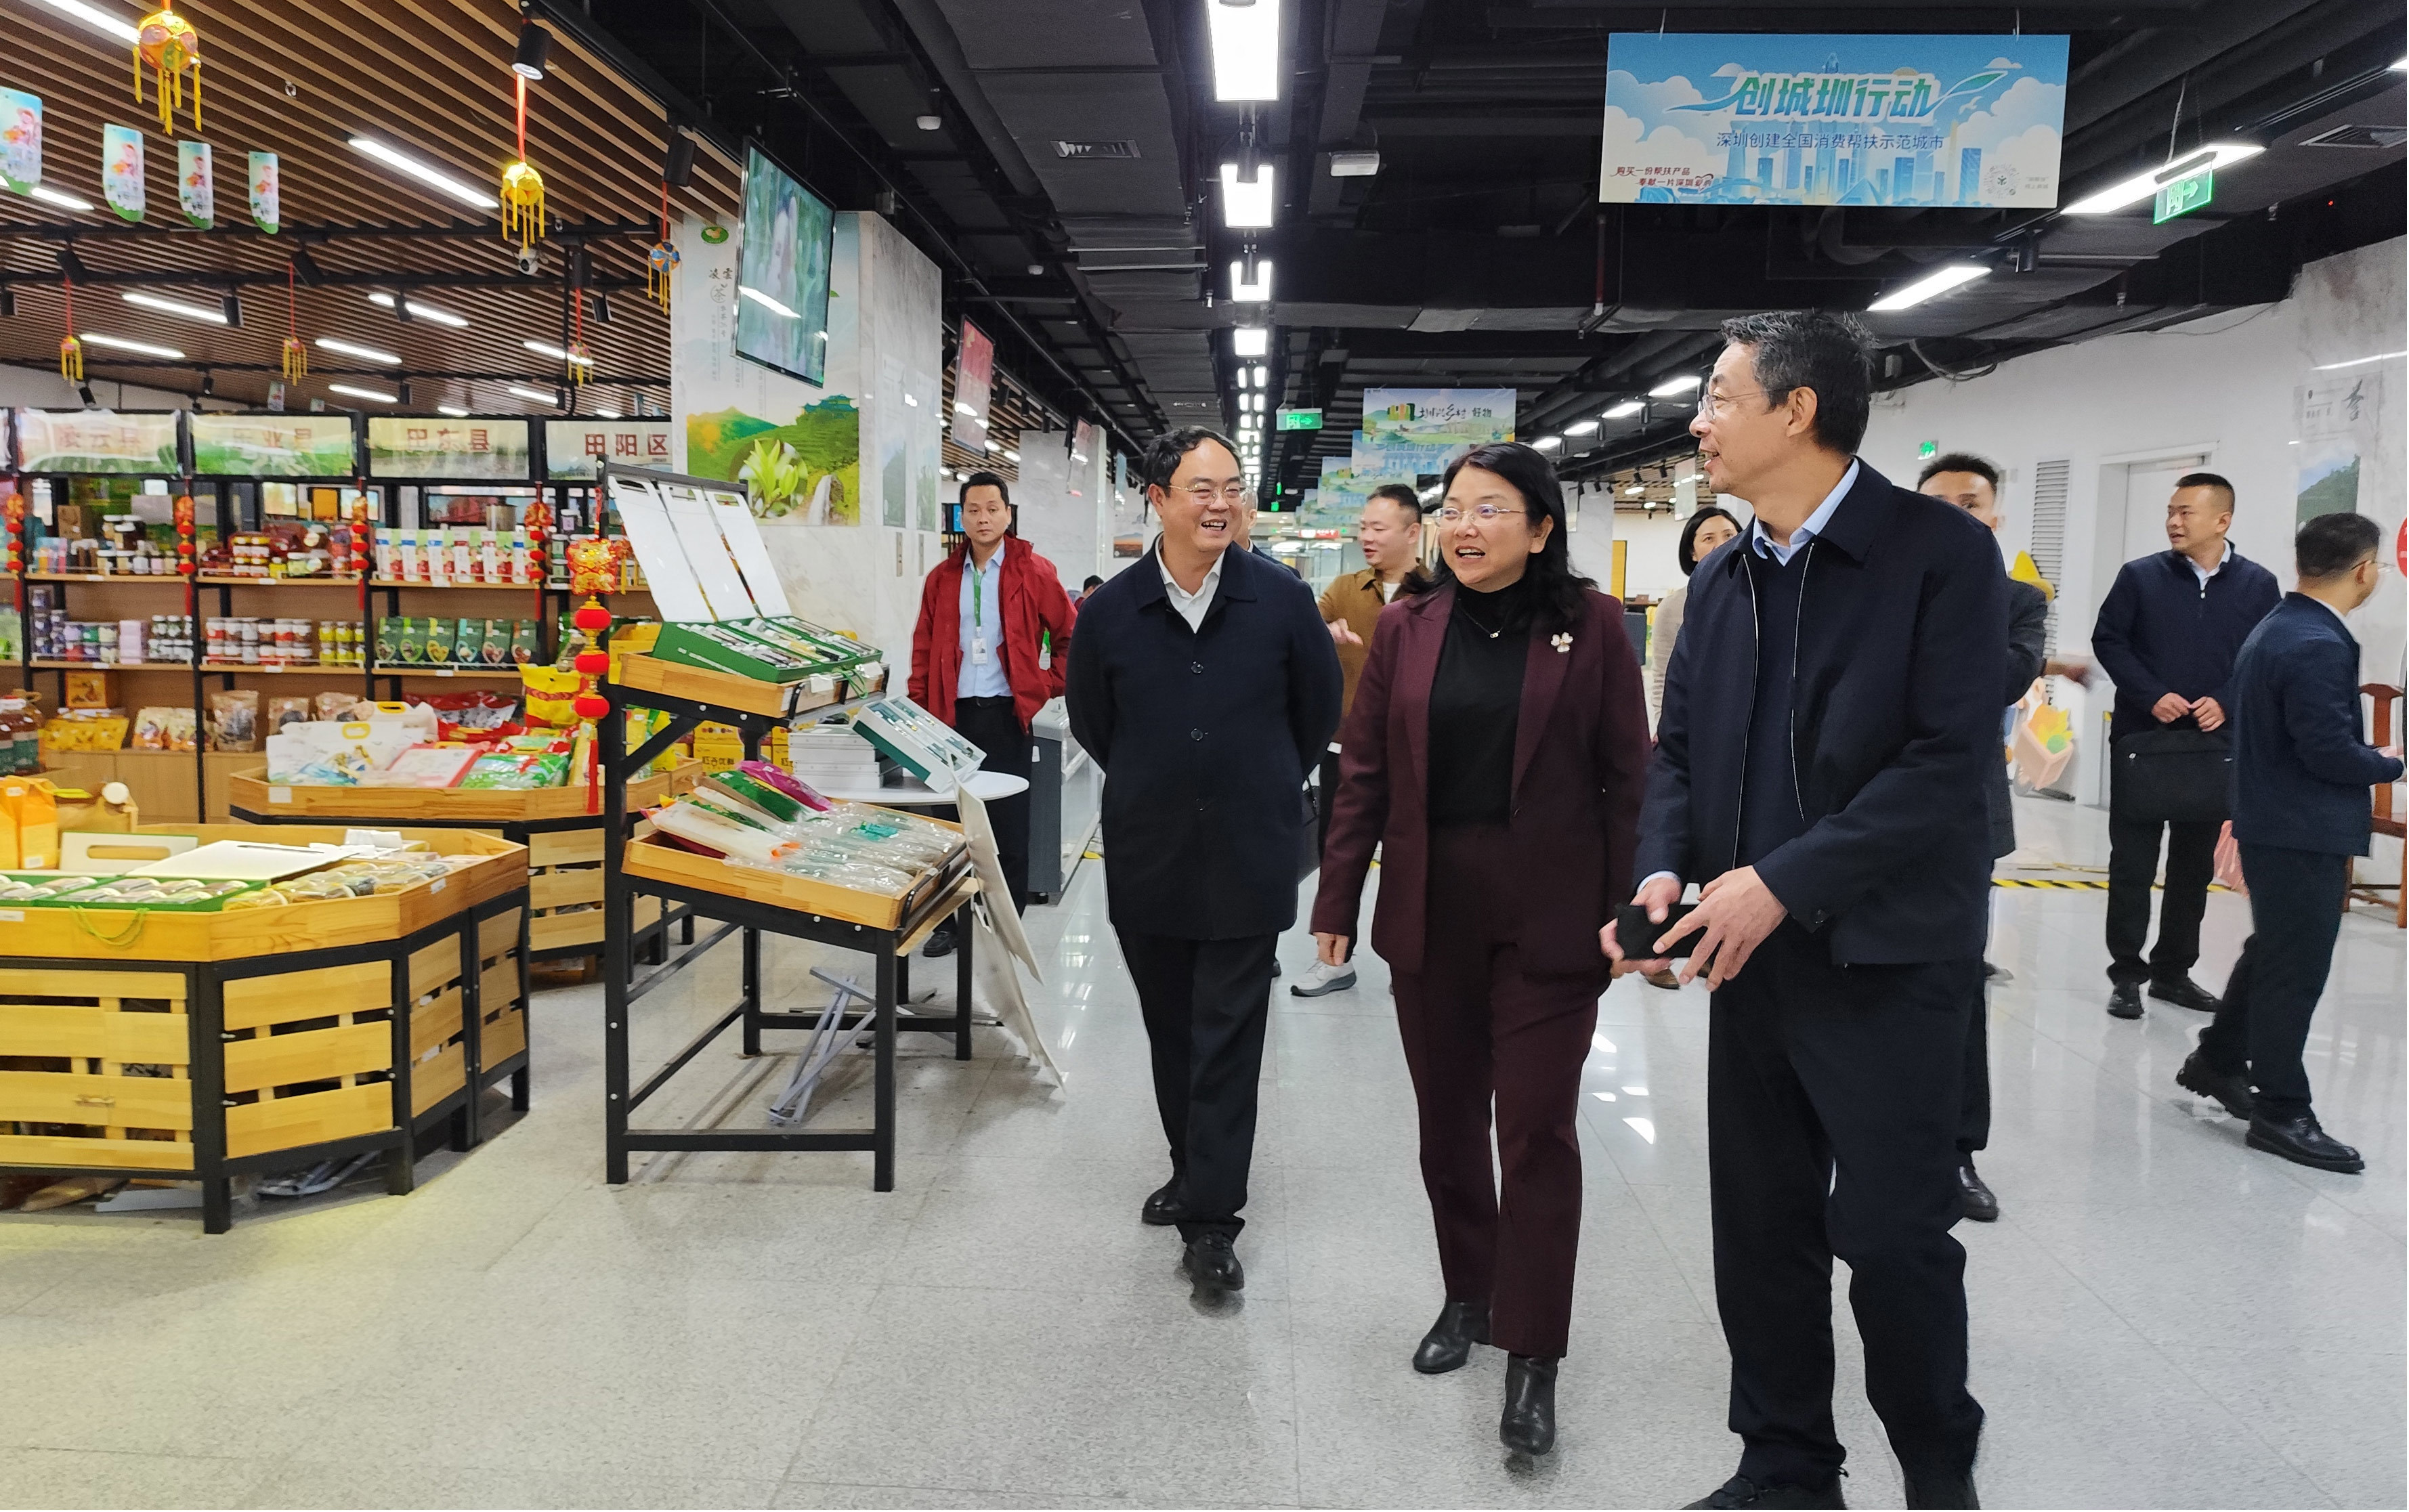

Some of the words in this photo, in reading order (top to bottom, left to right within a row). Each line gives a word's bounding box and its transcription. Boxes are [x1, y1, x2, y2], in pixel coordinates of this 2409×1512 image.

[1734, 77, 1935, 117] 创城圳行动
[1716, 132, 1944, 150] 深圳创建全国消费帮扶示范城市
[1611, 166, 1690, 177] 购买一份帮扶产品
[585, 433, 668, 456] 田阳区
